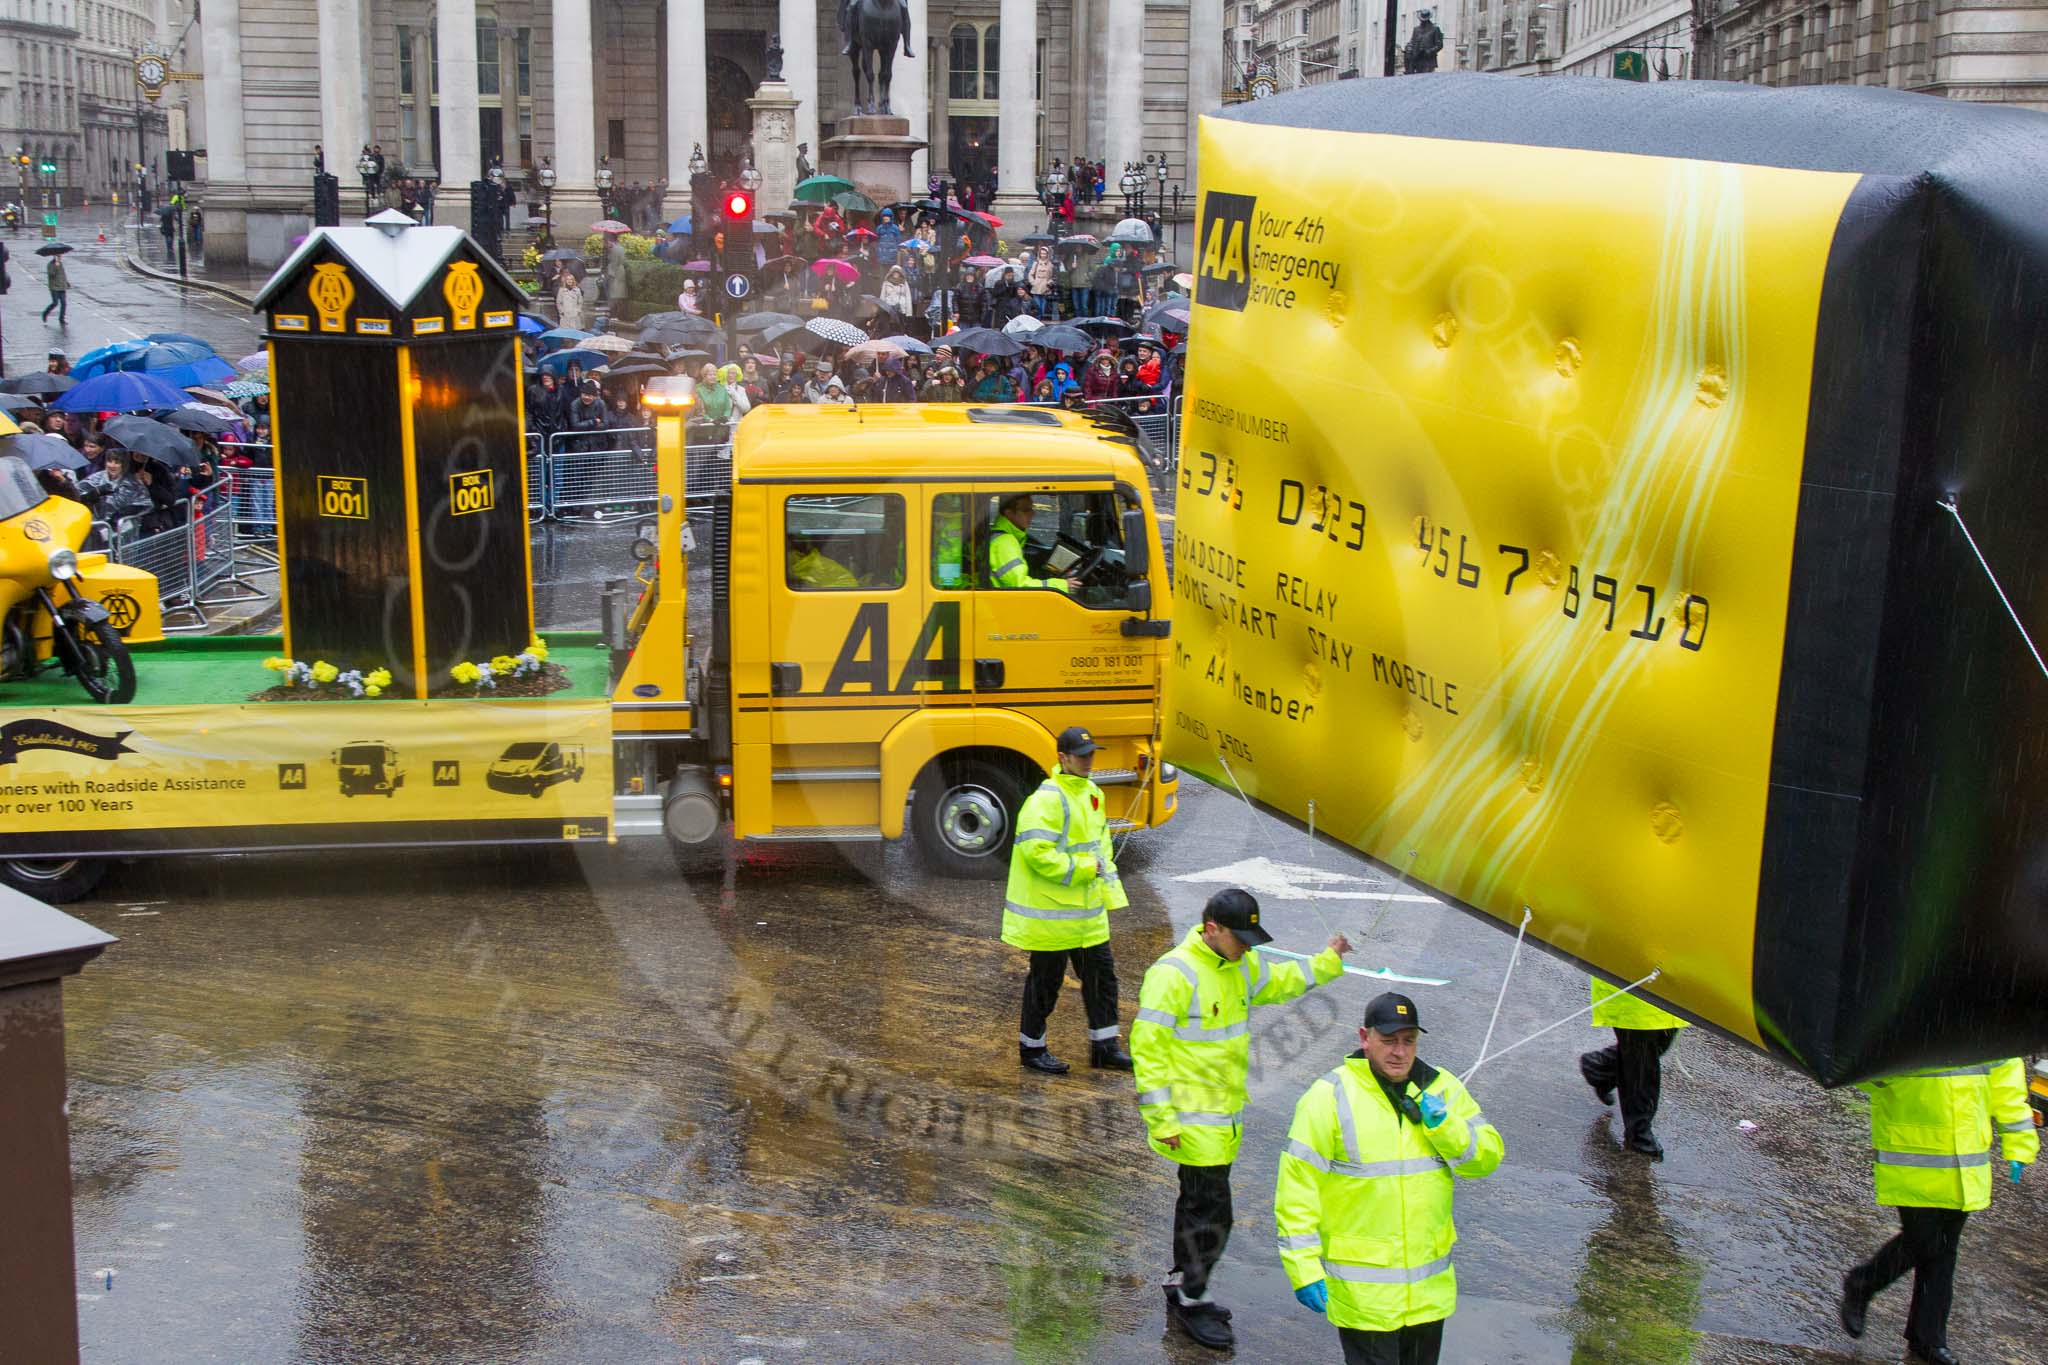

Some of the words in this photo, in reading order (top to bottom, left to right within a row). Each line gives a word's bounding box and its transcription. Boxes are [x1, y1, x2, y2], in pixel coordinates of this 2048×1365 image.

[1256, 209, 1293, 239] Your
[1294, 216, 1326, 245] 4th
[1200, 216, 1246, 284] AA
[1253, 245, 1341, 289] Emergency
[1193, 399, 1234, 427] MBERSHIP
[1235, 411, 1290, 444] NUMBER
[331, 480, 352, 491] BOX
[462, 475, 480, 486] BOX
[325, 492, 362, 515] 001
[457, 485, 489, 510] 001
[1177, 529, 1247, 588] ROADSIDE
[1276, 572, 1338, 623] RELAY
[822, 600, 961, 696] AA
[1219, 592, 1278, 640] START
[1308, 626, 1353, 673] STAY
[1372, 653, 1459, 716] MOBILE
[1070, 657, 1099, 668] 0800
[1104, 656, 1120, 667] 181
[1124, 655, 1143, 667] 001
[1205, 654, 1226, 688] AA
[1233, 669, 1314, 724] Member
[281, 769, 304, 784] AA
[435, 765, 457, 781] AA
[43, 780, 80, 795] with
[85, 779, 158, 794] Roadside
[163, 777, 247, 792] Assistance
[16, 803, 52, 814] over
[57, 799, 86, 813] 100
[91, 798, 133, 812] Years
